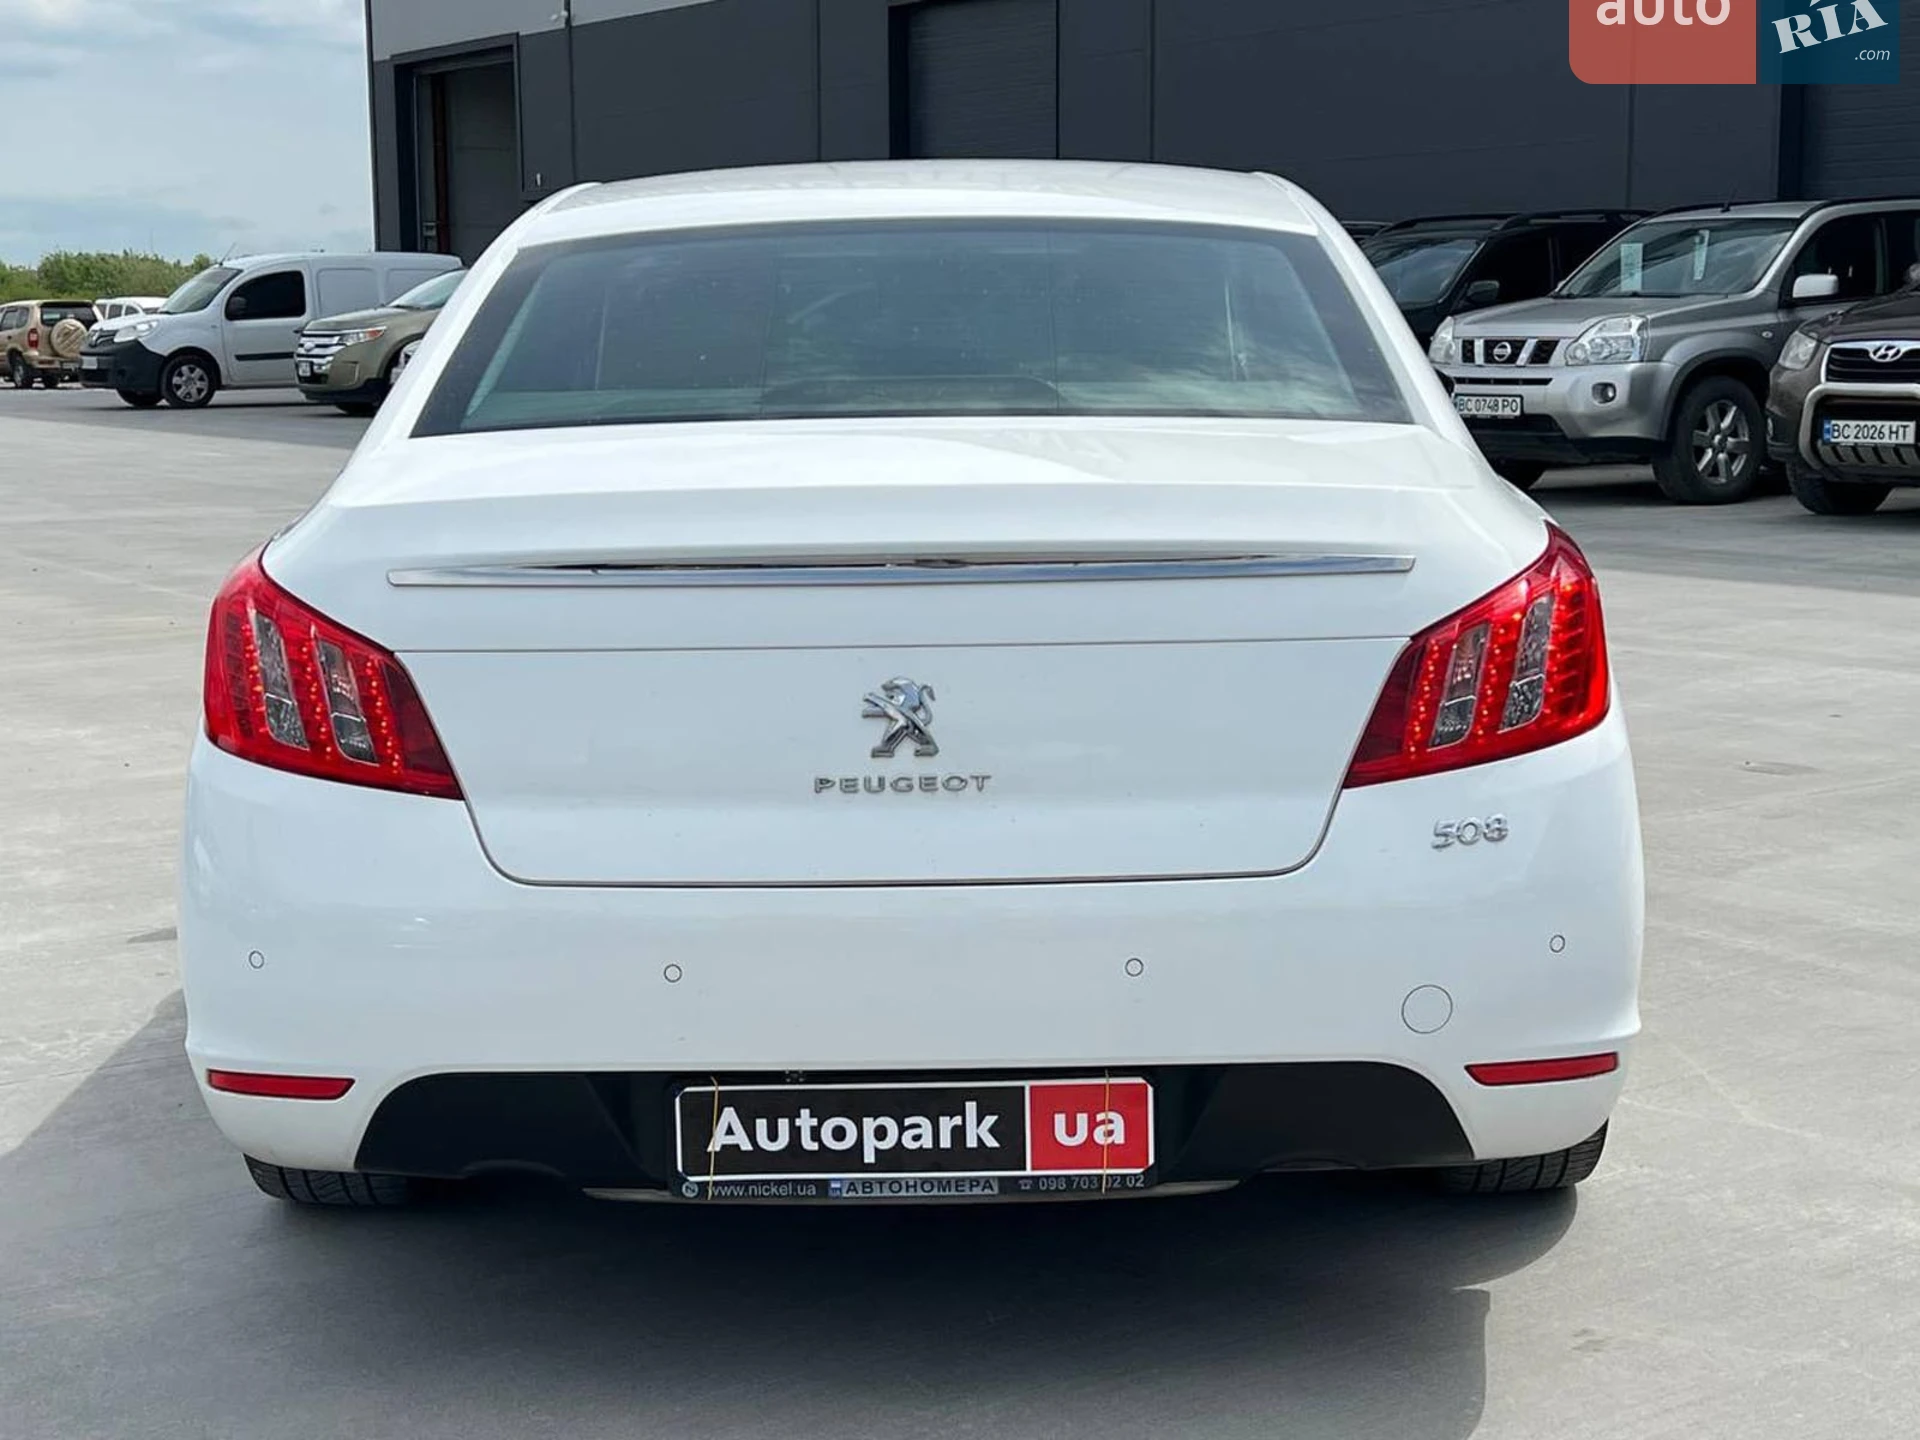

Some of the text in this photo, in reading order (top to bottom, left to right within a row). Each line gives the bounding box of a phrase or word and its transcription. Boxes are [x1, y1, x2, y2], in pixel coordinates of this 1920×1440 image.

[1458, 398, 1518, 413] BC 0748 PO
[1831, 423, 1910, 441] BC 2026 HT
[814, 775, 992, 794] PEUGEOT
[1431, 813, 1509, 850] 508
[707, 1100, 1125, 1164] Autopark ua
[845, 1178, 995, 1195] АВТОНОМЕРА
[1071, 1176, 1099, 1189] 703
[1126, 1174, 1145, 1188] 02
